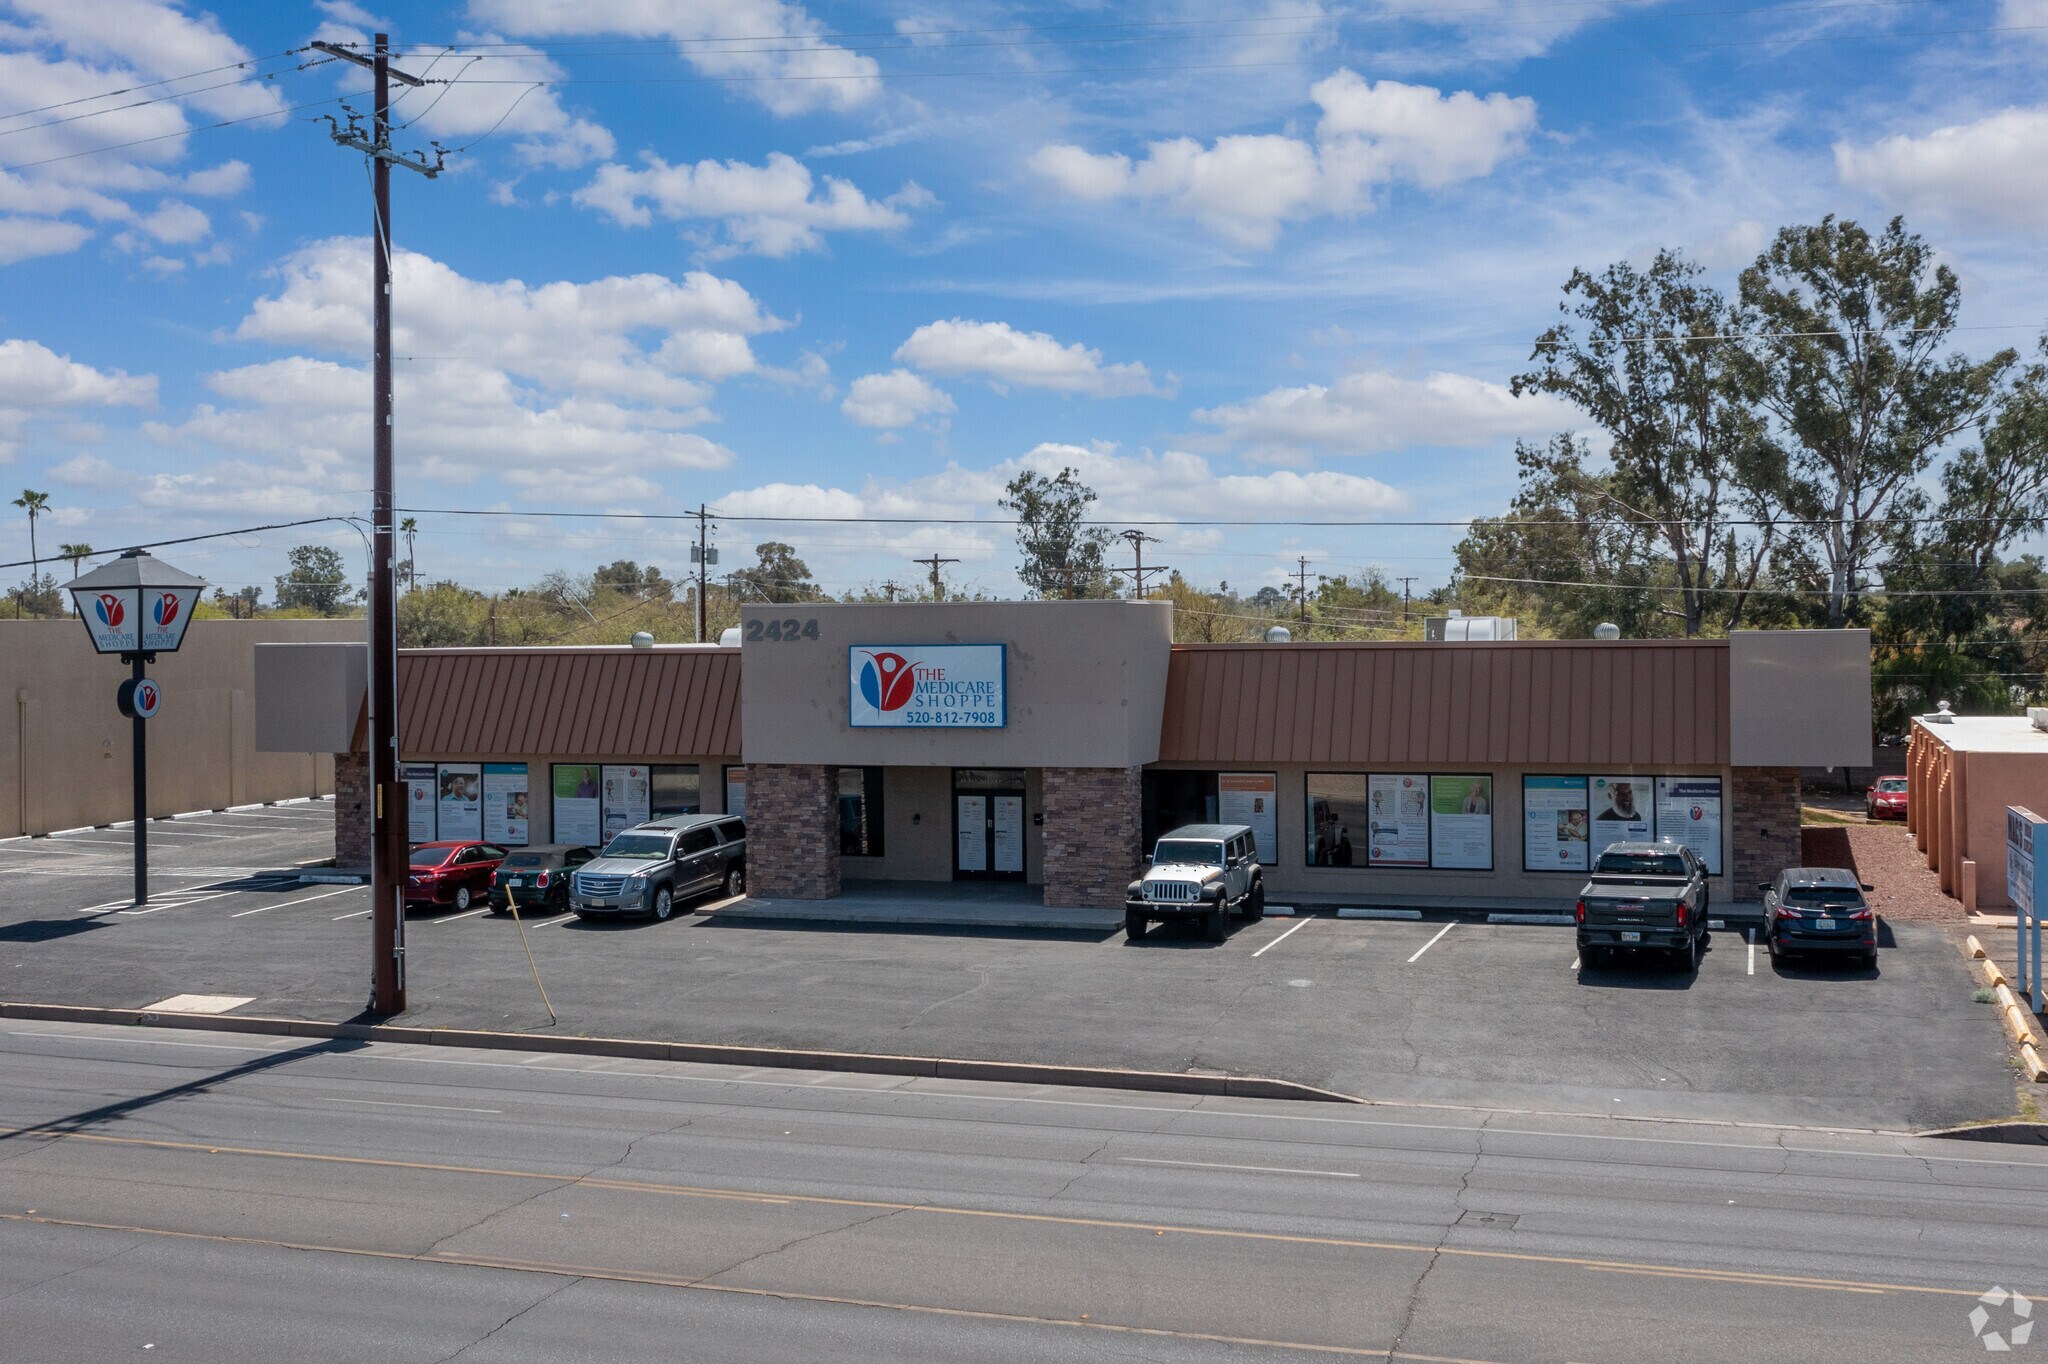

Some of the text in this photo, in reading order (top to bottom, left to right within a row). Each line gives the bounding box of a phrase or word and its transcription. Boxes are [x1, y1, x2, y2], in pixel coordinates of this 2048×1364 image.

[746, 619, 820, 642] 2424
[100, 640, 136, 648] SHOPPE
[915, 668, 945, 681] THE
[915, 681, 995, 694] MEDICARE
[915, 694, 995, 708] SHOPPE
[906, 711, 995, 724] 520-812-7908
